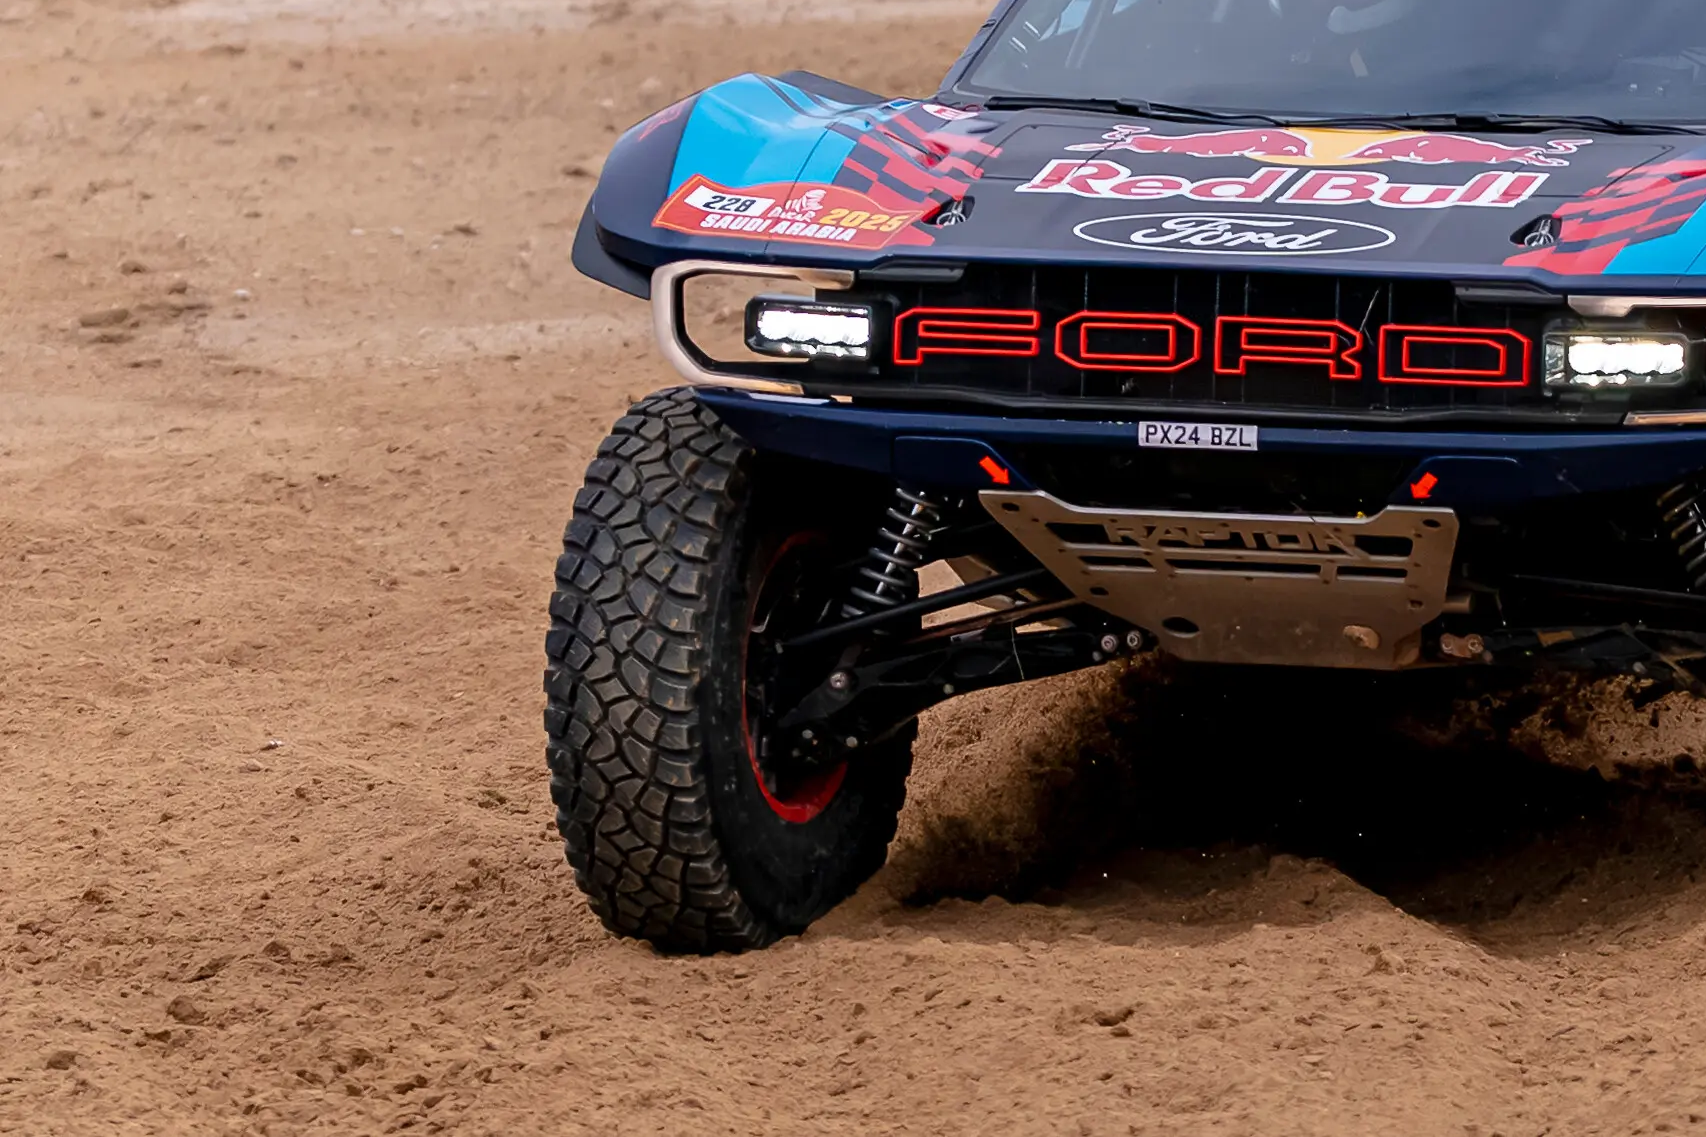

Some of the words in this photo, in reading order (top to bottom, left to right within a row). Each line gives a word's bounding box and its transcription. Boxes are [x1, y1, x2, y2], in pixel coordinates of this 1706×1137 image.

[1015, 159, 1300, 203] Red
[1276, 169, 1550, 208] Bull
[700, 213, 771, 233] SAUDI
[769, 220, 857, 242] ARABIA
[767, 206, 816, 223] DAKAR
[819, 208, 911, 232] 2025
[1129, 216, 1340, 252] Ford
[893, 306, 1531, 386] FORD
[1145, 424, 1201, 446] PX24
[1210, 426, 1252, 448] BZL
[1103, 517, 1370, 561] RAPTOR
